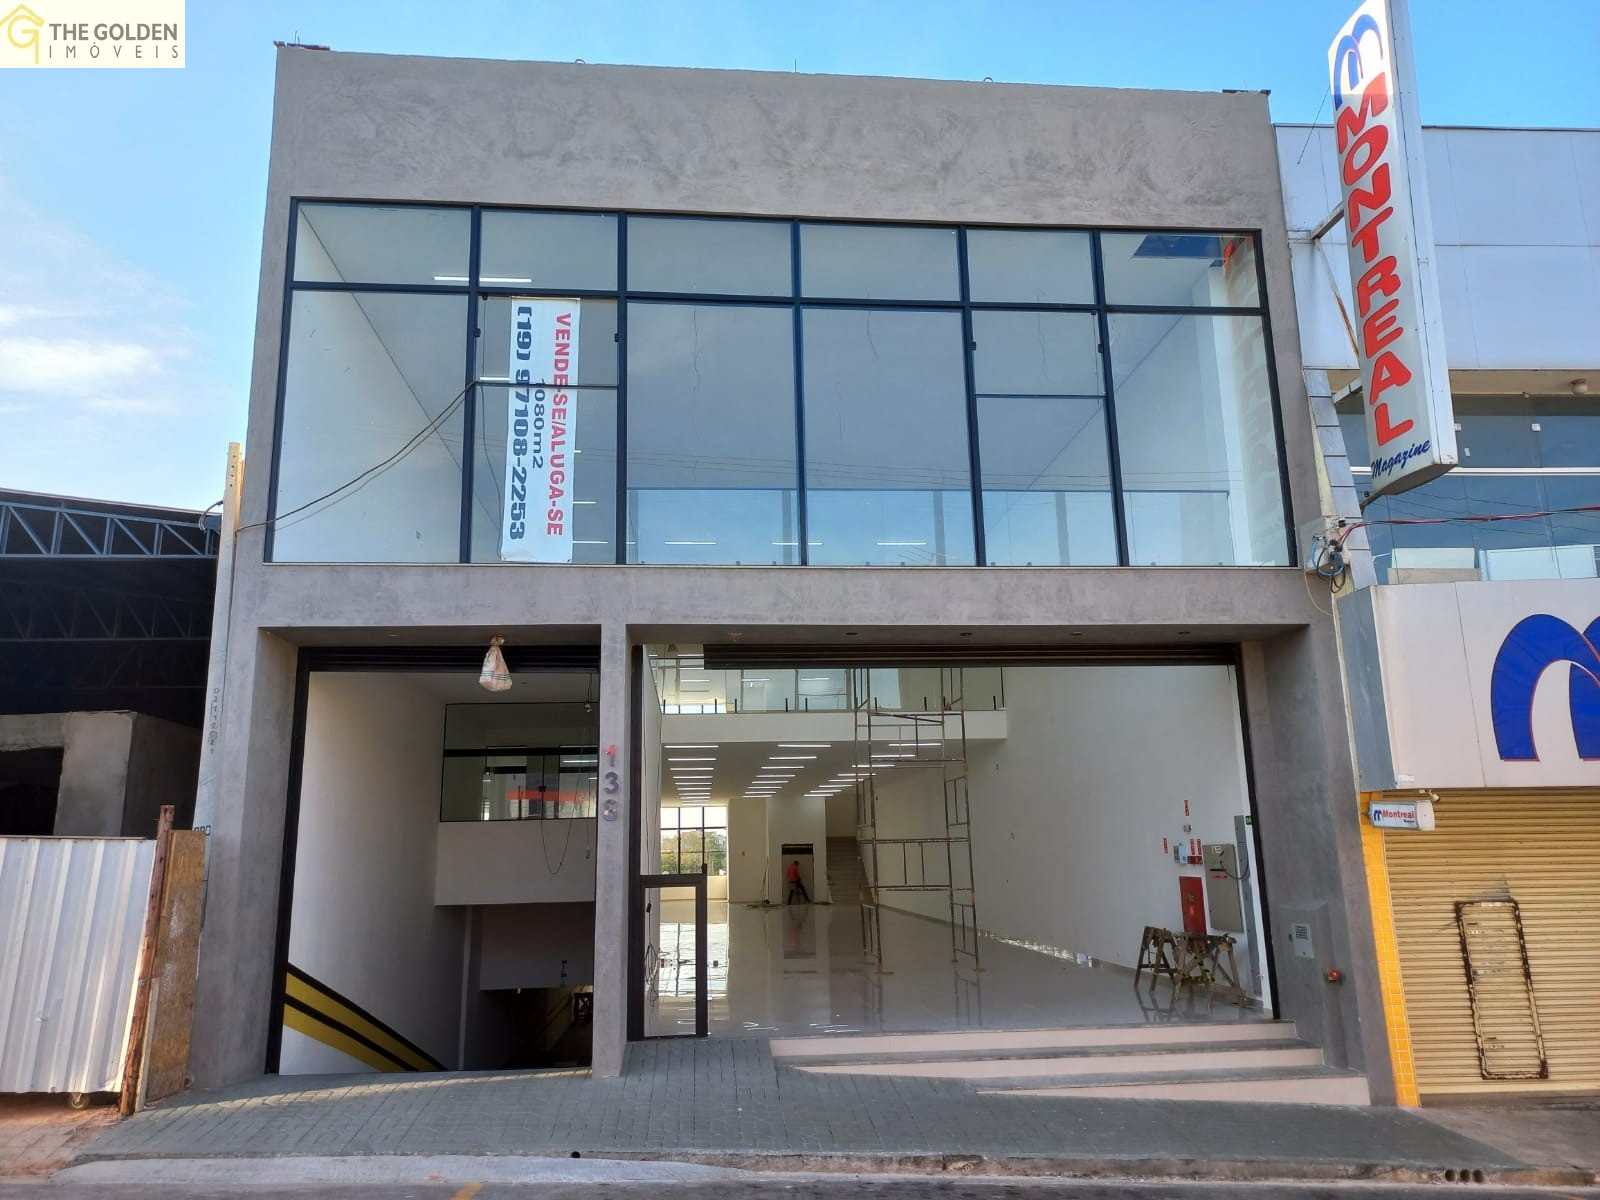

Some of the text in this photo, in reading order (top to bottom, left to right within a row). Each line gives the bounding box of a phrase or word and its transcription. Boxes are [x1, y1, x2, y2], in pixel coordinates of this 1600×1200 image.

[1337, 71, 1414, 447] MONTREAL
[509, 369, 531, 541] 97108-2253
[546, 313, 572, 536] VENDE-SE/ALUGA-SE
[1371, 440, 1430, 479] Magazine
[1382, 809, 1415, 819] Montreal
